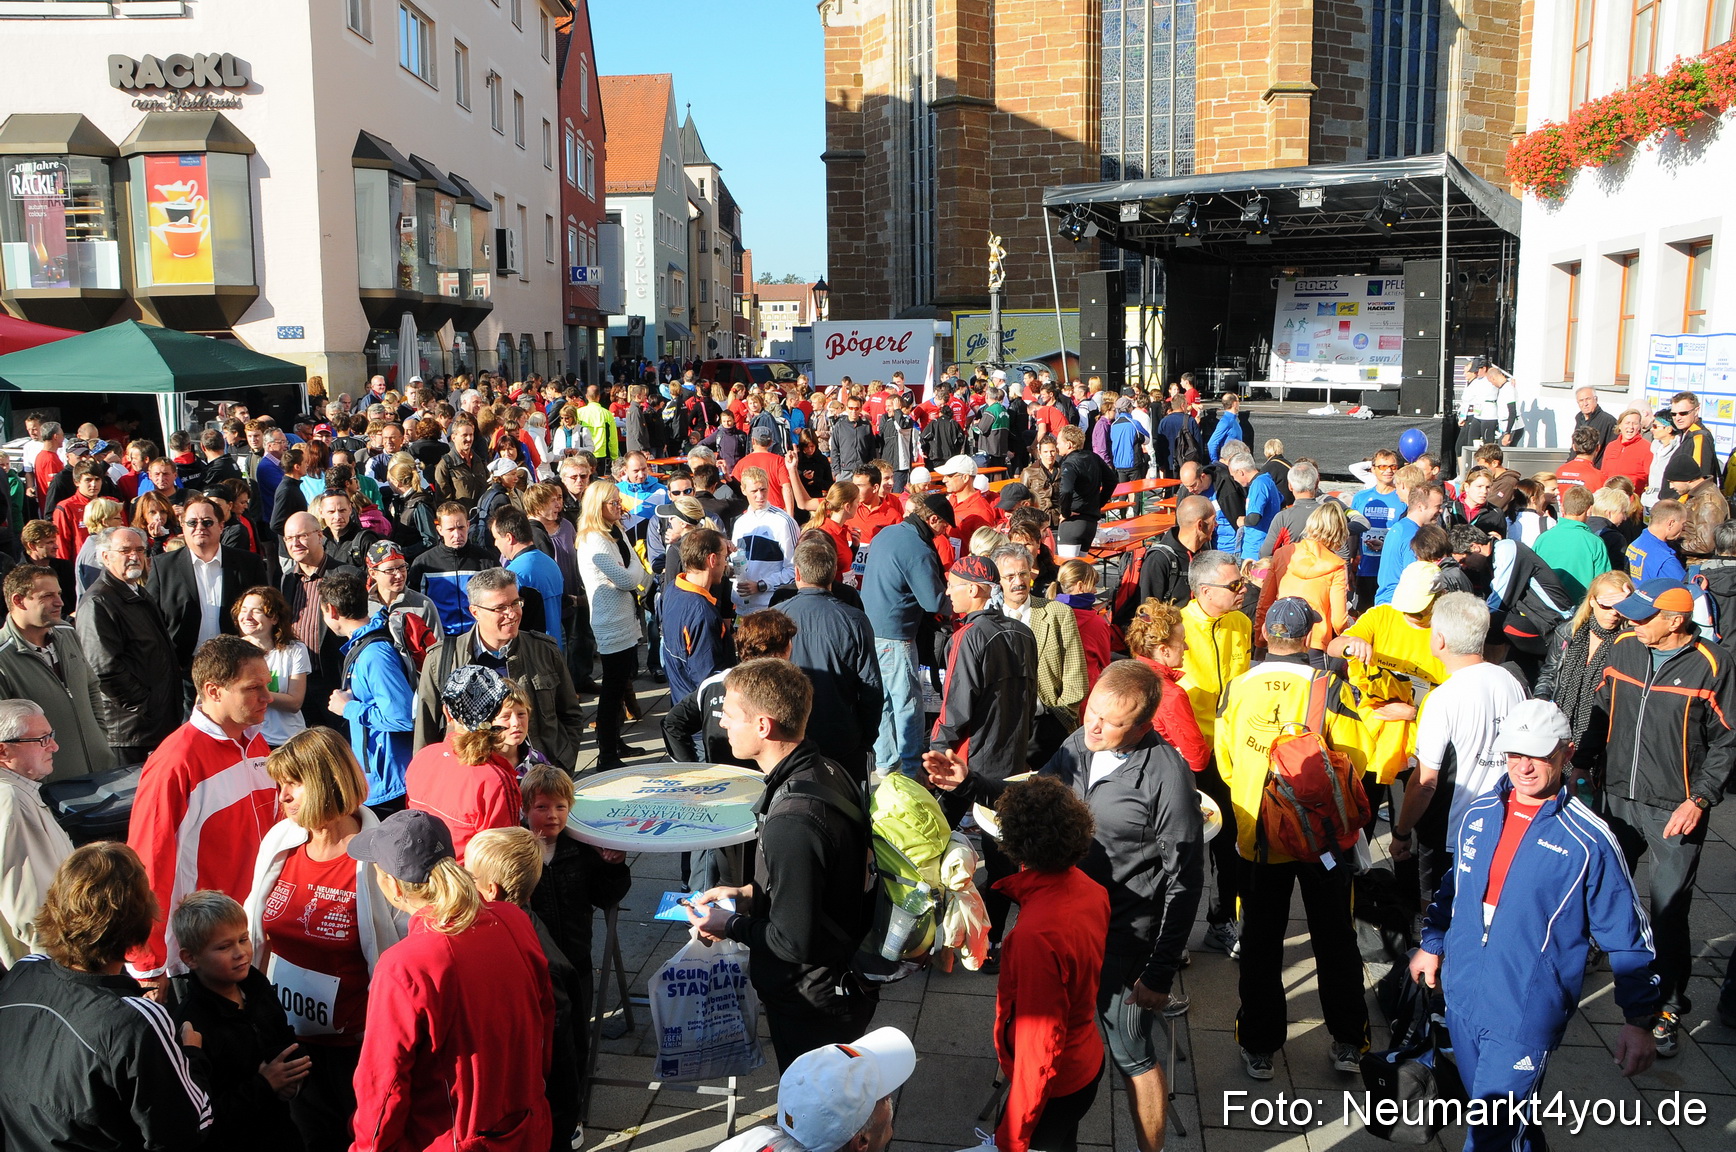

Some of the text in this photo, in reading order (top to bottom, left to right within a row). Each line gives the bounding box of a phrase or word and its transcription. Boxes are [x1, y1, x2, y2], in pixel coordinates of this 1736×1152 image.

[107, 52, 249, 89] RACKL
[164, 89, 244, 111] Rathaus
[32, 160, 60, 172] Jahre
[12, 174, 56, 194] RACKL
[1294, 280, 1338, 291] BOCK
[825, 331, 913, 360] Bögerl
[966, 328, 1018, 357] Gloer
[891, 358, 920, 366] Marktplatz
[1369, 355, 1390, 363] swn
[1377, 658, 1397, 668] Heinz
[1264, 680, 1291, 692] TSV
[642, 778, 685, 787] Bier
[632, 782, 730, 796] Glossner
[624, 803, 710, 814] MINERALBRUNNEN
[606, 807, 718, 823] NEUMARKTER
[1537, 838, 1562, 854] Schmidt
[307, 883, 316, 891] 11.
[313, 891, 351, 904] STADTLAUF
[716, 1003, 730, 1011] km
